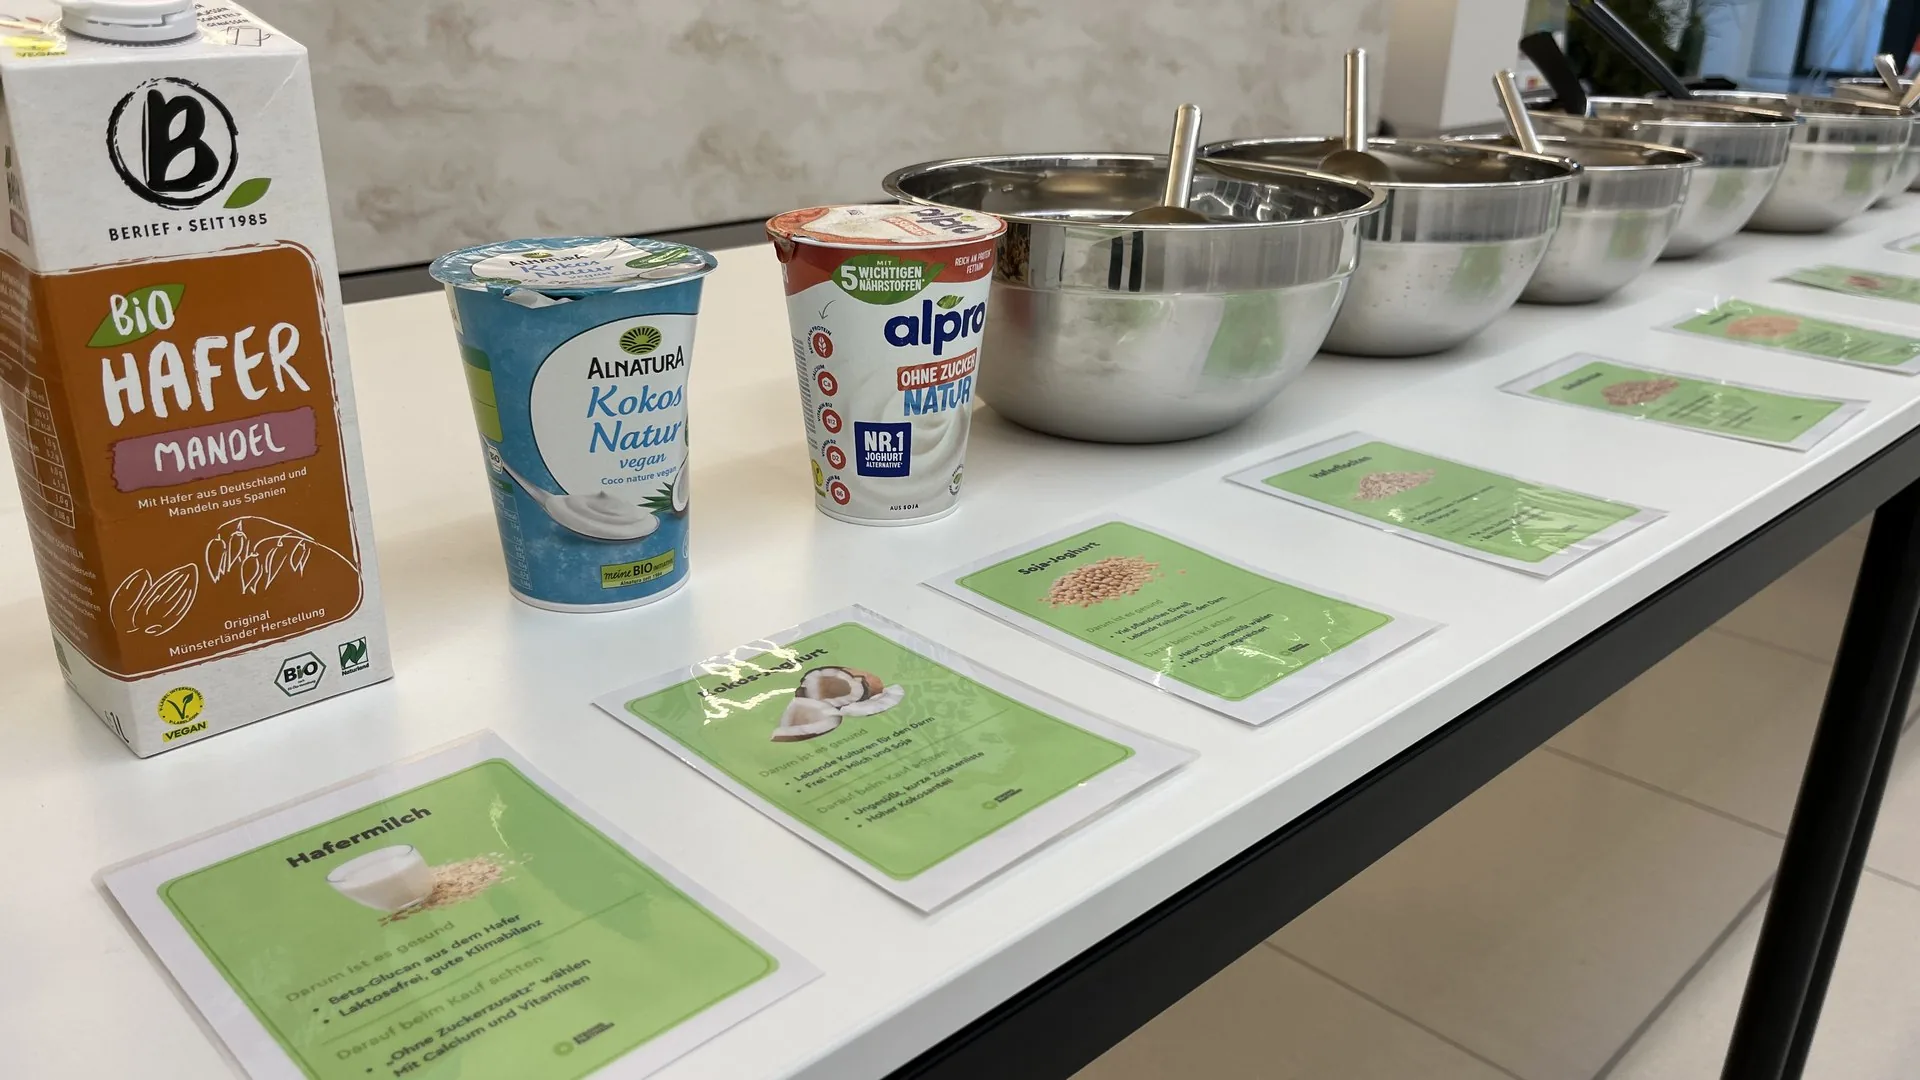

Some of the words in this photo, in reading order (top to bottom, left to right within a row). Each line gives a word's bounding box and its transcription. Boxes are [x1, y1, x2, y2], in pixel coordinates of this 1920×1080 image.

[109, 222, 170, 241] BERIEF
[189, 216, 224, 232] SEIT
[229, 212, 268, 228] 1985
[520, 260, 600, 273] Kokos
[840, 265, 858, 291] 5
[859, 265, 922, 279] WICHTIGEN
[955, 256, 970, 266] REICH
[884, 299, 986, 356] alpro
[101, 322, 311, 426] HAFER
[587, 345, 685, 380] ALNATURA
[901, 369, 937, 387] OHNE
[940, 353, 976, 381] ZUCKER
[586, 384, 682, 419] Kokos
[904, 375, 971, 416] NATUR
[154, 422, 286, 472] MANDEL
[589, 418, 682, 453] Natur
[864, 431, 904, 452] NR.1
[619, 452, 667, 472] vegan
[865, 452, 903, 462] JOGHURT
[138, 496, 157, 509] Mit
[160, 492, 193, 505] Hafer
[196, 488, 217, 499] aus
[220, 471, 286, 495] Deutschland
[288, 466, 307, 480] und
[601, 476, 624, 486] Coco
[626, 471, 655, 484] nature
[657, 466, 677, 478] vegan
[169, 501, 219, 517] Mandeln
[222, 497, 242, 508] aus
[244, 487, 286, 504] Spanien
[604, 569, 632, 580] meine
[633, 562, 653, 576] BIO
[1018, 542, 1101, 575] Soja-Joghurt
[169, 627, 257, 657] Münsterländer
[261, 607, 325, 633] Herstellung
[224, 610, 270, 631] Original
[1086, 620, 1115, 633] Darum
[1135, 599, 1164, 614] gesund
[1127, 624, 1159, 640] Lebende
[1157, 613, 1184, 628] Kulturen
[1196, 603, 1208, 611] den
[165, 721, 206, 740] VEGAN
[759, 760, 798, 777] Darum
[797, 752, 814, 762] ist
[829, 728, 868, 749] gesund
[793, 760, 837, 781] Lebende
[836, 742, 878, 762] Kulturen
[876, 734, 891, 744] für
[892, 727, 909, 738] den
[909, 716, 935, 730] Darm
[805, 776, 826, 788] Frei
[826, 767, 847, 779] von
[845, 756, 873, 771] Milch
[872, 746, 891, 758] und
[891, 737, 912, 750] Soja
[854, 779, 886, 796] beim
[884, 765, 911, 782] Kauf
[903, 775, 931, 791] kurze
[930, 751, 984, 778] Zutatenliste
[865, 806, 898, 823] Hoher
[897, 778, 953, 808] Kokosanteil
[286, 806, 432, 869] Hafermilch
[286, 970, 345, 1002] Darum
[346, 959, 371, 974] ist
[374, 951, 392, 962] es
[396, 920, 455, 954] gesund
[328, 961, 421, 1005] Beta-Glucan
[424, 948, 448, 963] aus
[451, 931, 482, 949] dem
[483, 913, 521, 934] Hafer
[338, 973, 429, 1017] Laktosefrei,
[430, 956, 464, 976] gute
[465, 919, 543, 957] Klimabilanz
[540, 957, 591, 985] wählen
[335, 1026, 396, 1060] Darauf
[398, 1004, 445, 1031] beim
[447, 981, 486, 1007] Kauf
[488, 955, 545, 986] achten
[393, 1060, 421, 1078] Mit
[423, 1025, 486, 1063] Calcium
[488, 1008, 517, 1029] und
[517, 973, 591, 1012] Vitaminen
